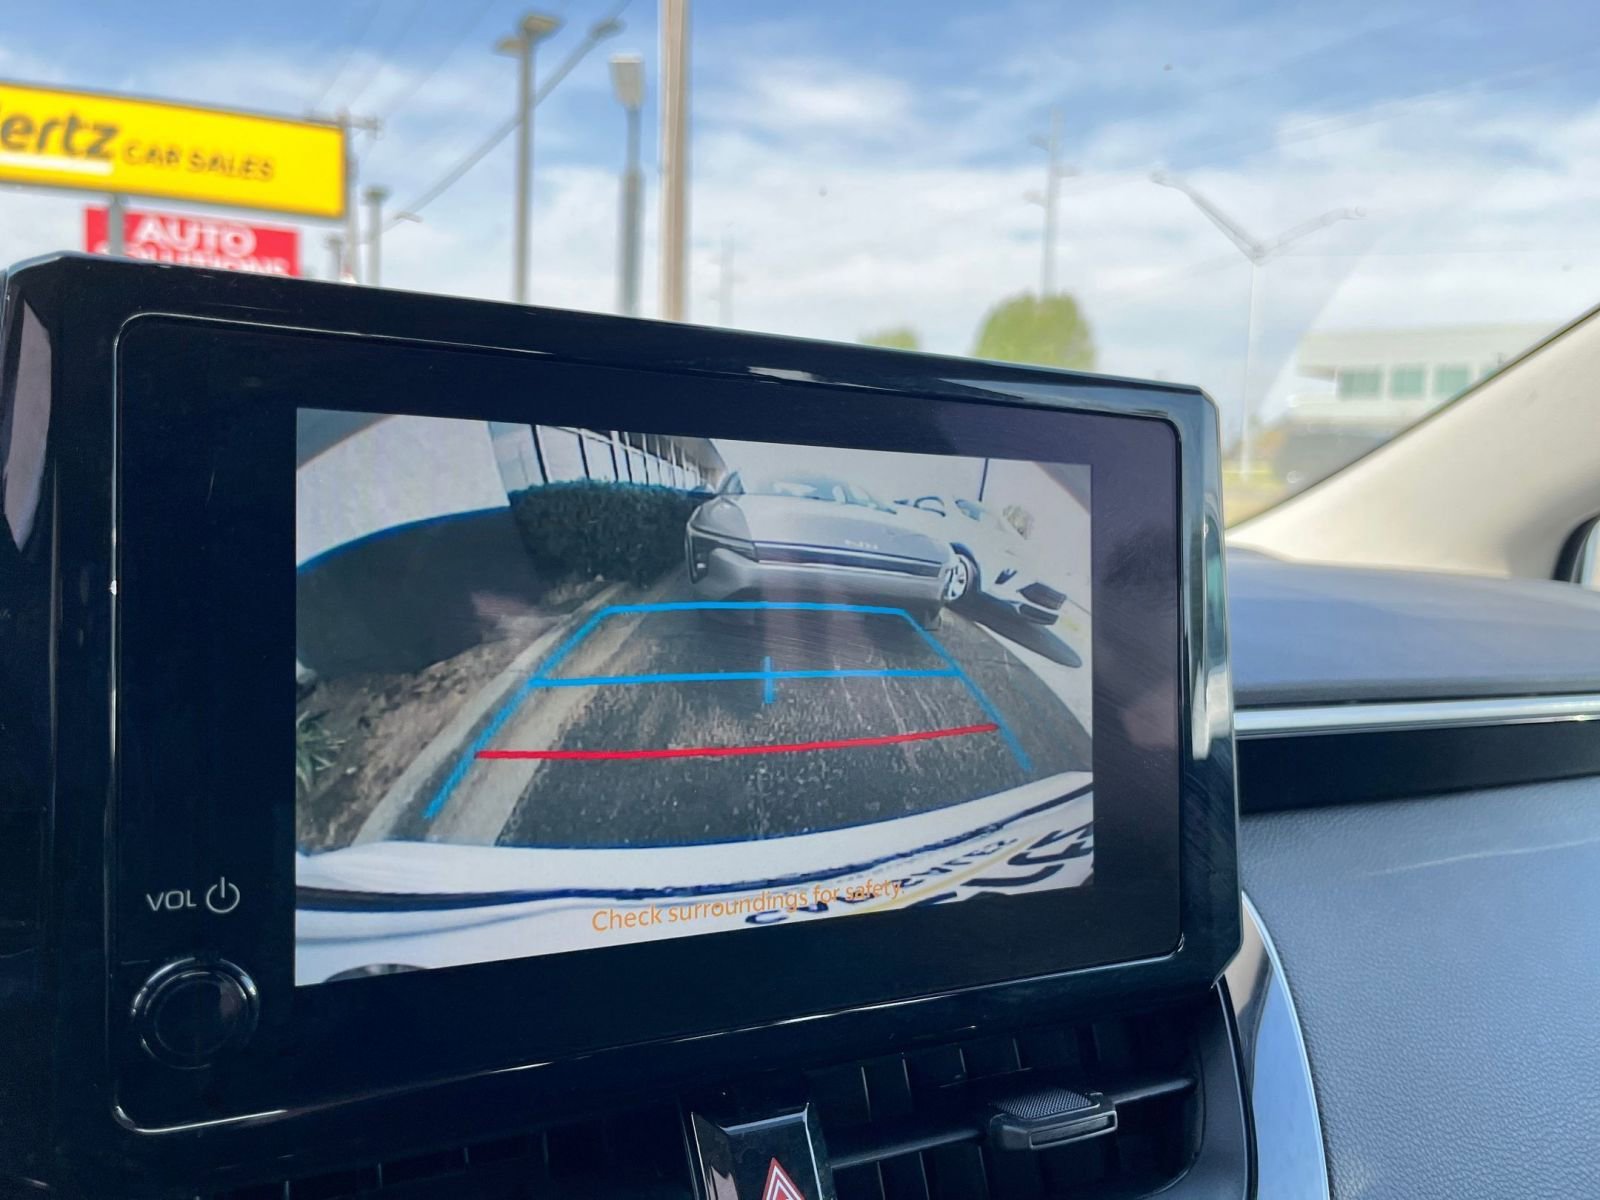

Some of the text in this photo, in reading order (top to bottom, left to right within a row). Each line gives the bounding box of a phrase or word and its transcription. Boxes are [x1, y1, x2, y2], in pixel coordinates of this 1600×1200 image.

[0, 109, 119, 160] ertz
[188, 148, 275, 181] SALES
[135, 215, 257, 257] AUTO
[146, 889, 197, 911] VOL
[592, 904, 662, 932] Check
[668, 892, 808, 923] surroundings
[813, 884, 840, 904] for
